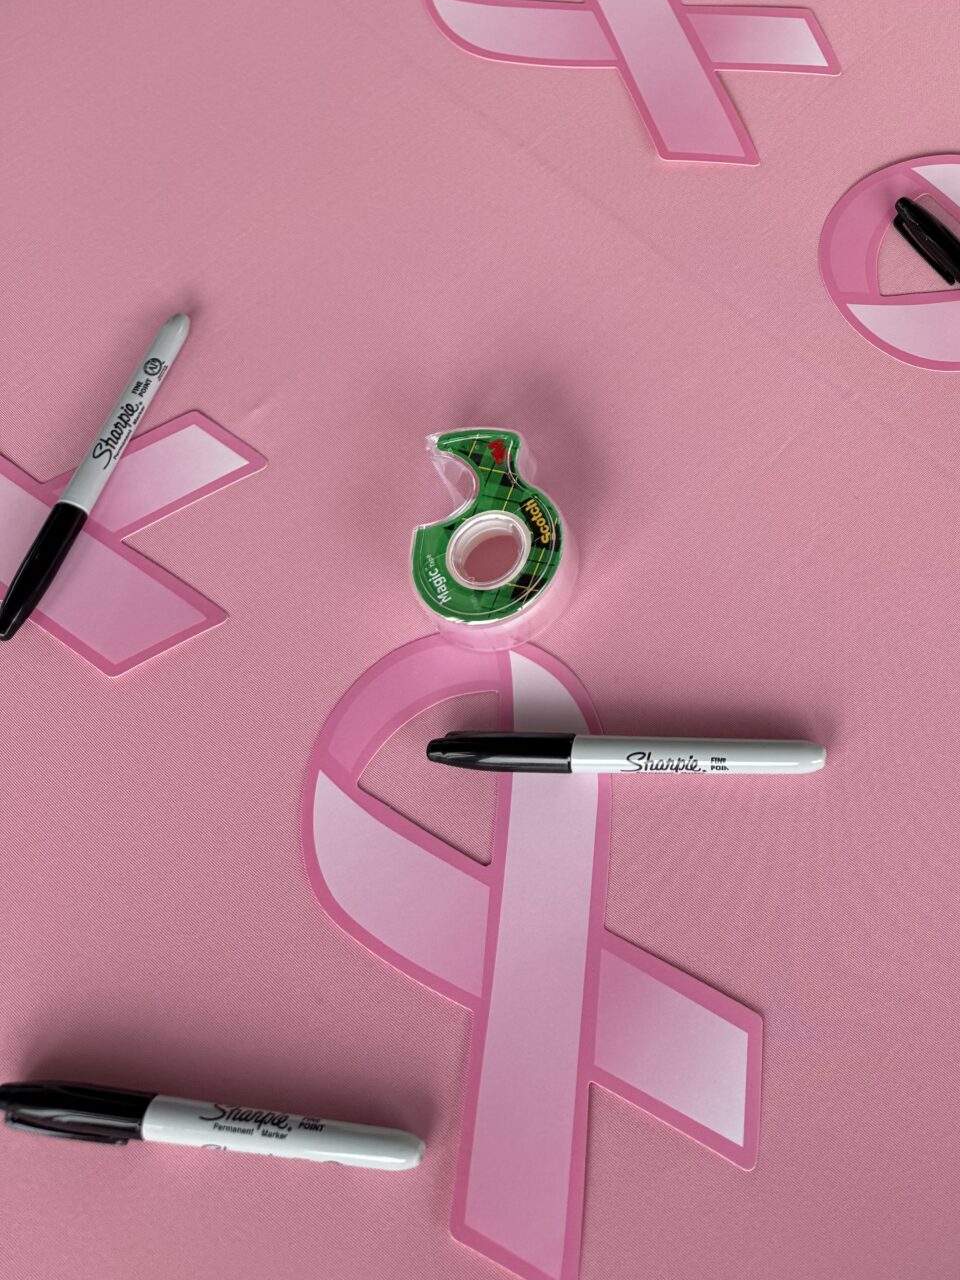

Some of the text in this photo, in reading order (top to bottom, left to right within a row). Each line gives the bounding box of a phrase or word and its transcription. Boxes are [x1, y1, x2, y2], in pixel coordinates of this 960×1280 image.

[131, 381, 142, 394] FINE
[138, 378, 152, 397] POINT
[93, 402, 138, 470] Sharpie
[523, 497, 554, 544] Scotch
[428, 567, 452, 605] Magic
[620, 752, 701, 772] Sharpie
[213, 1122, 288, 1139] Permanent Marker
[299, 1122, 325, 1132] POINT
